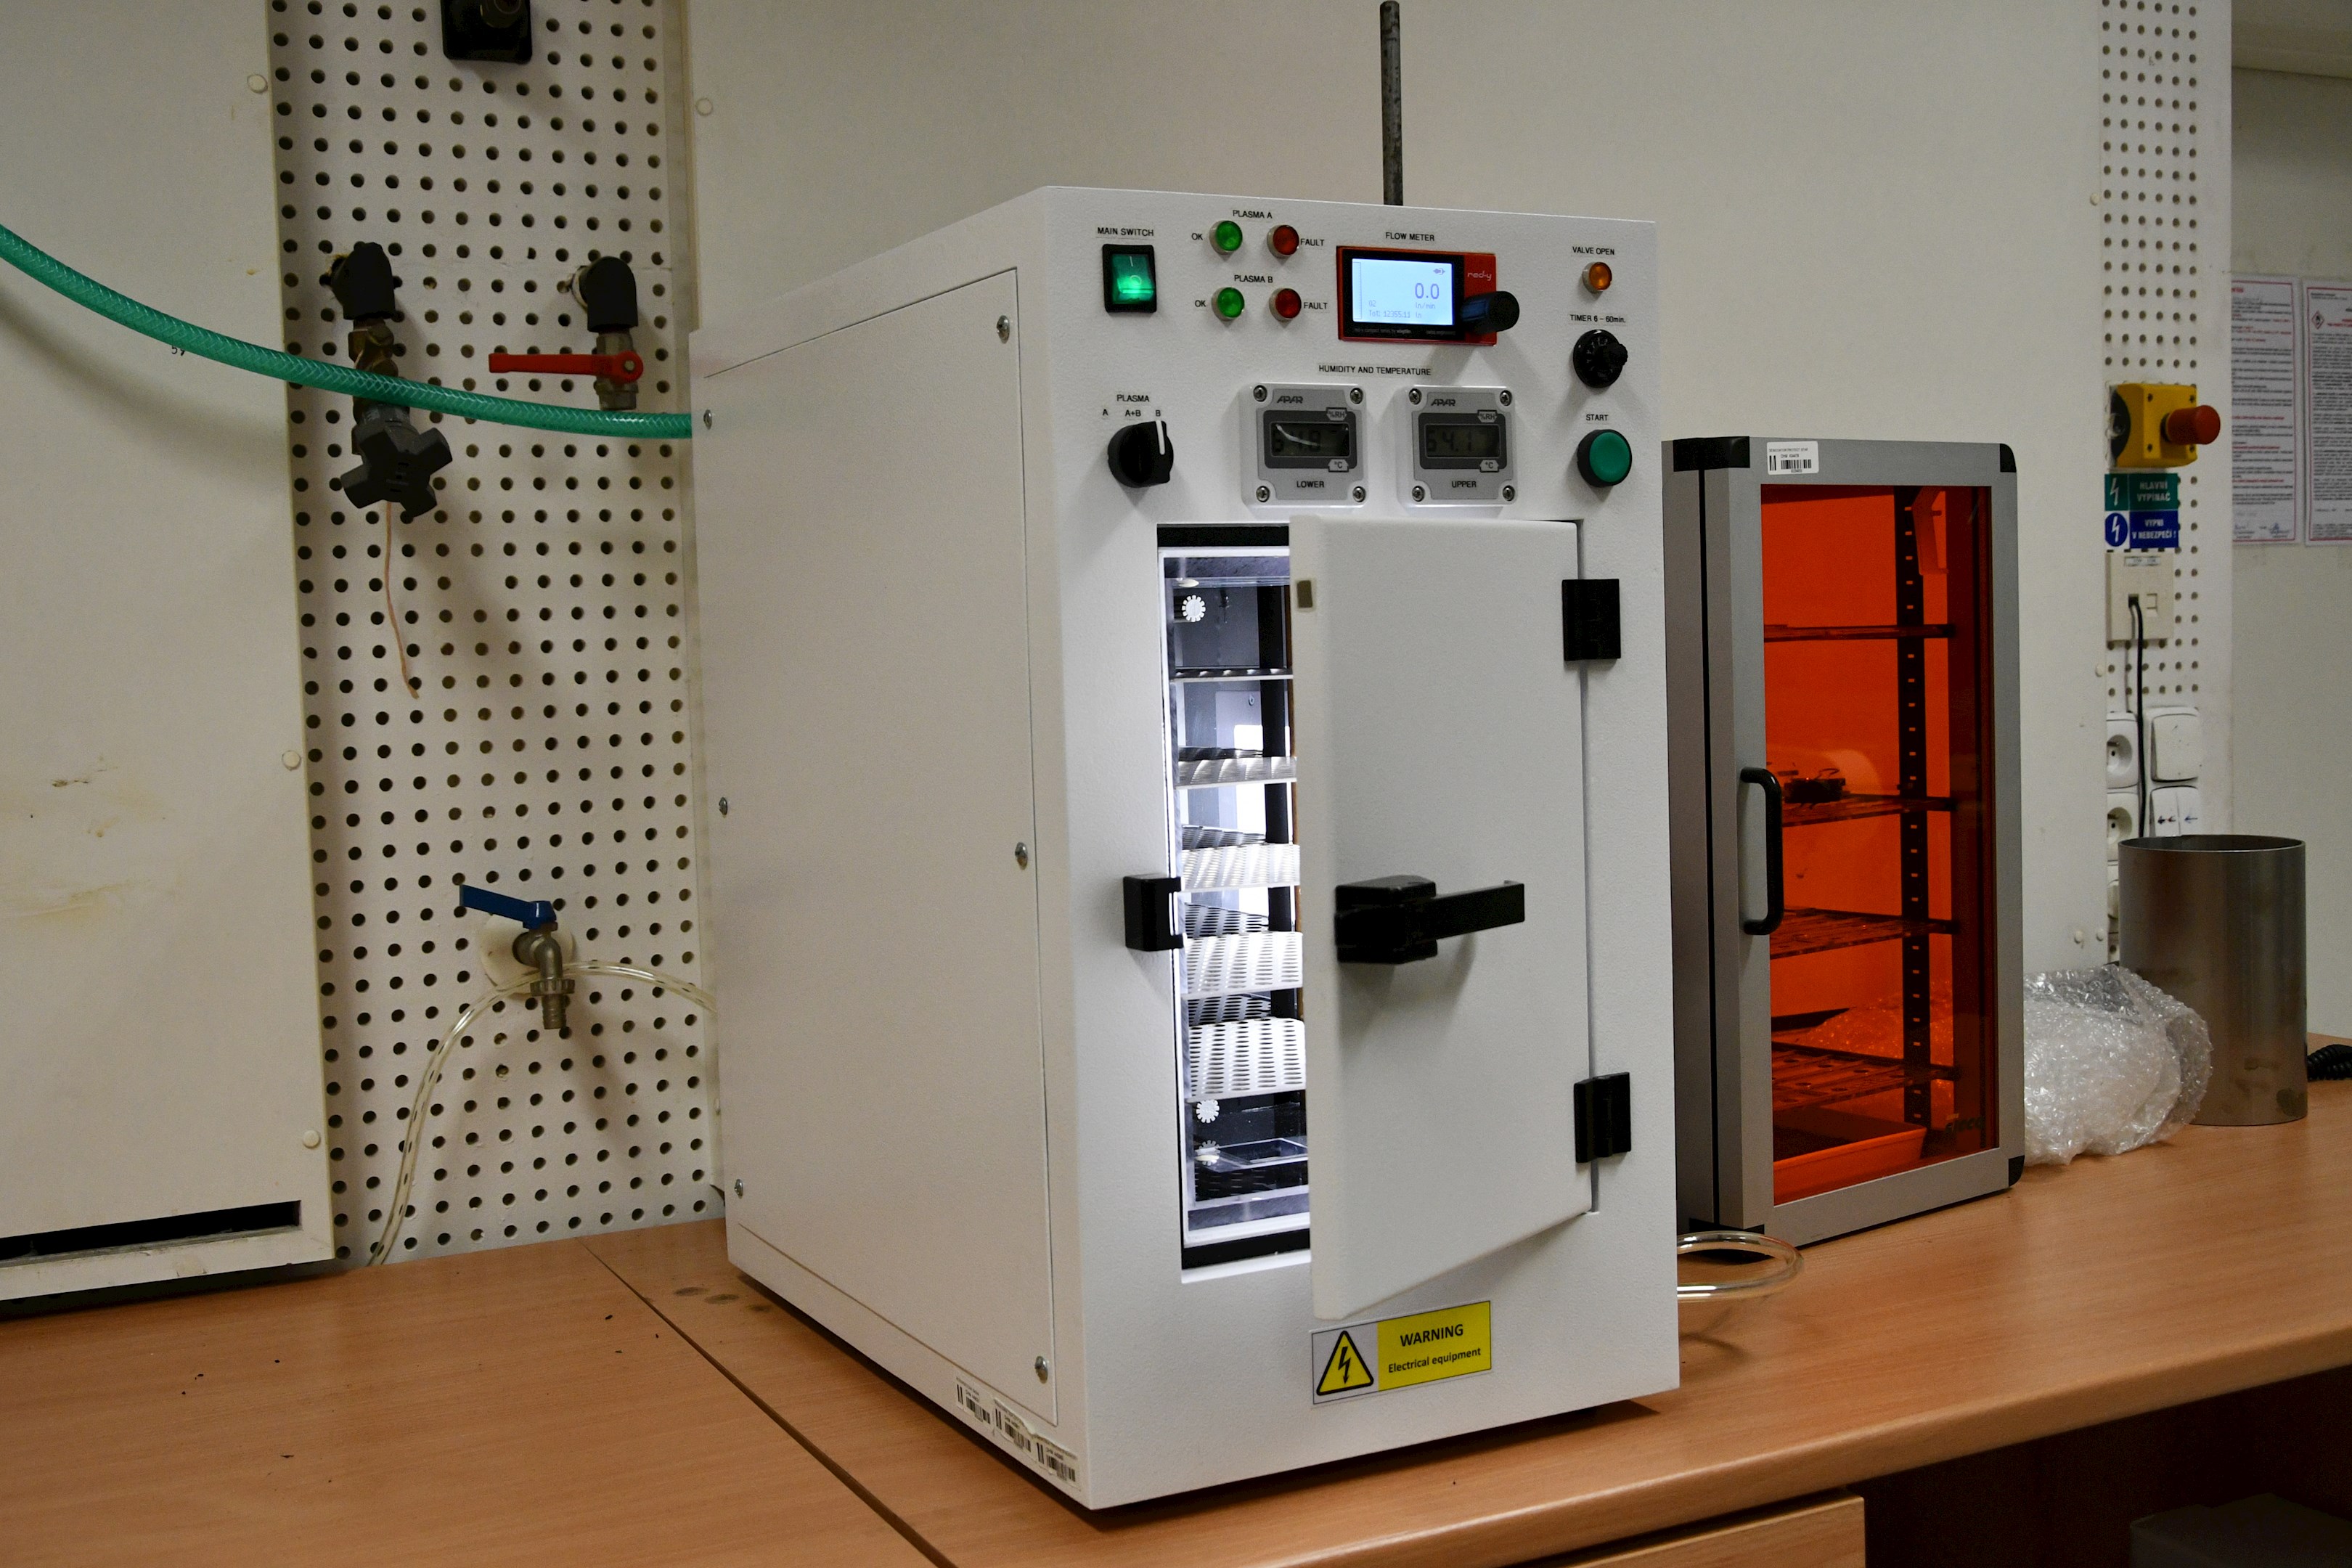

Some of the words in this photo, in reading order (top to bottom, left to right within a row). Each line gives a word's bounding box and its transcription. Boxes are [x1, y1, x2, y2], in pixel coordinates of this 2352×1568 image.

[1232, 210, 1265, 219] PLASMA
[1097, 226, 1118, 236] MAIN
[1120, 228, 1154, 237] SWITCH
[1191, 232, 1204, 241] OK
[1385, 232, 1407, 241] FLOW
[1409, 233, 1435, 242] METER
[1300, 238, 1325, 247] FAULT
[1572, 246, 1594, 255] VALVE
[1234, 274, 1265, 283] PLASMA
[1467, 270, 1493, 282] red-y
[1415, 282, 1440, 299] 0.0
[1194, 299, 1206, 308] OK
[1303, 302, 1328, 311] FAULT
[1605, 315, 1626, 324] 60min.
[1318, 364, 1355, 373] HUMIDITY
[1376, 367, 1432, 375] TEMPERATURE
[1116, 393, 1150, 402] PLASMA
[1276, 395, 1304, 404] APAR
[1124, 409, 1142, 417] A+B
[1334, 460, 1343, 469] °C
[1296, 480, 1325, 489] LOWER
[1451, 480, 1477, 489] UPPER
[2139, 481, 2168, 490] HLAVNÍ
[2137, 491, 2171, 502] VYPÍNAČ
[2131, 531, 2137, 539] V
[1400, 1323, 1464, 1347] WARNING
[1388, 1357, 1429, 1373] Electrical
[1432, 1347, 1482, 1368] equipment
